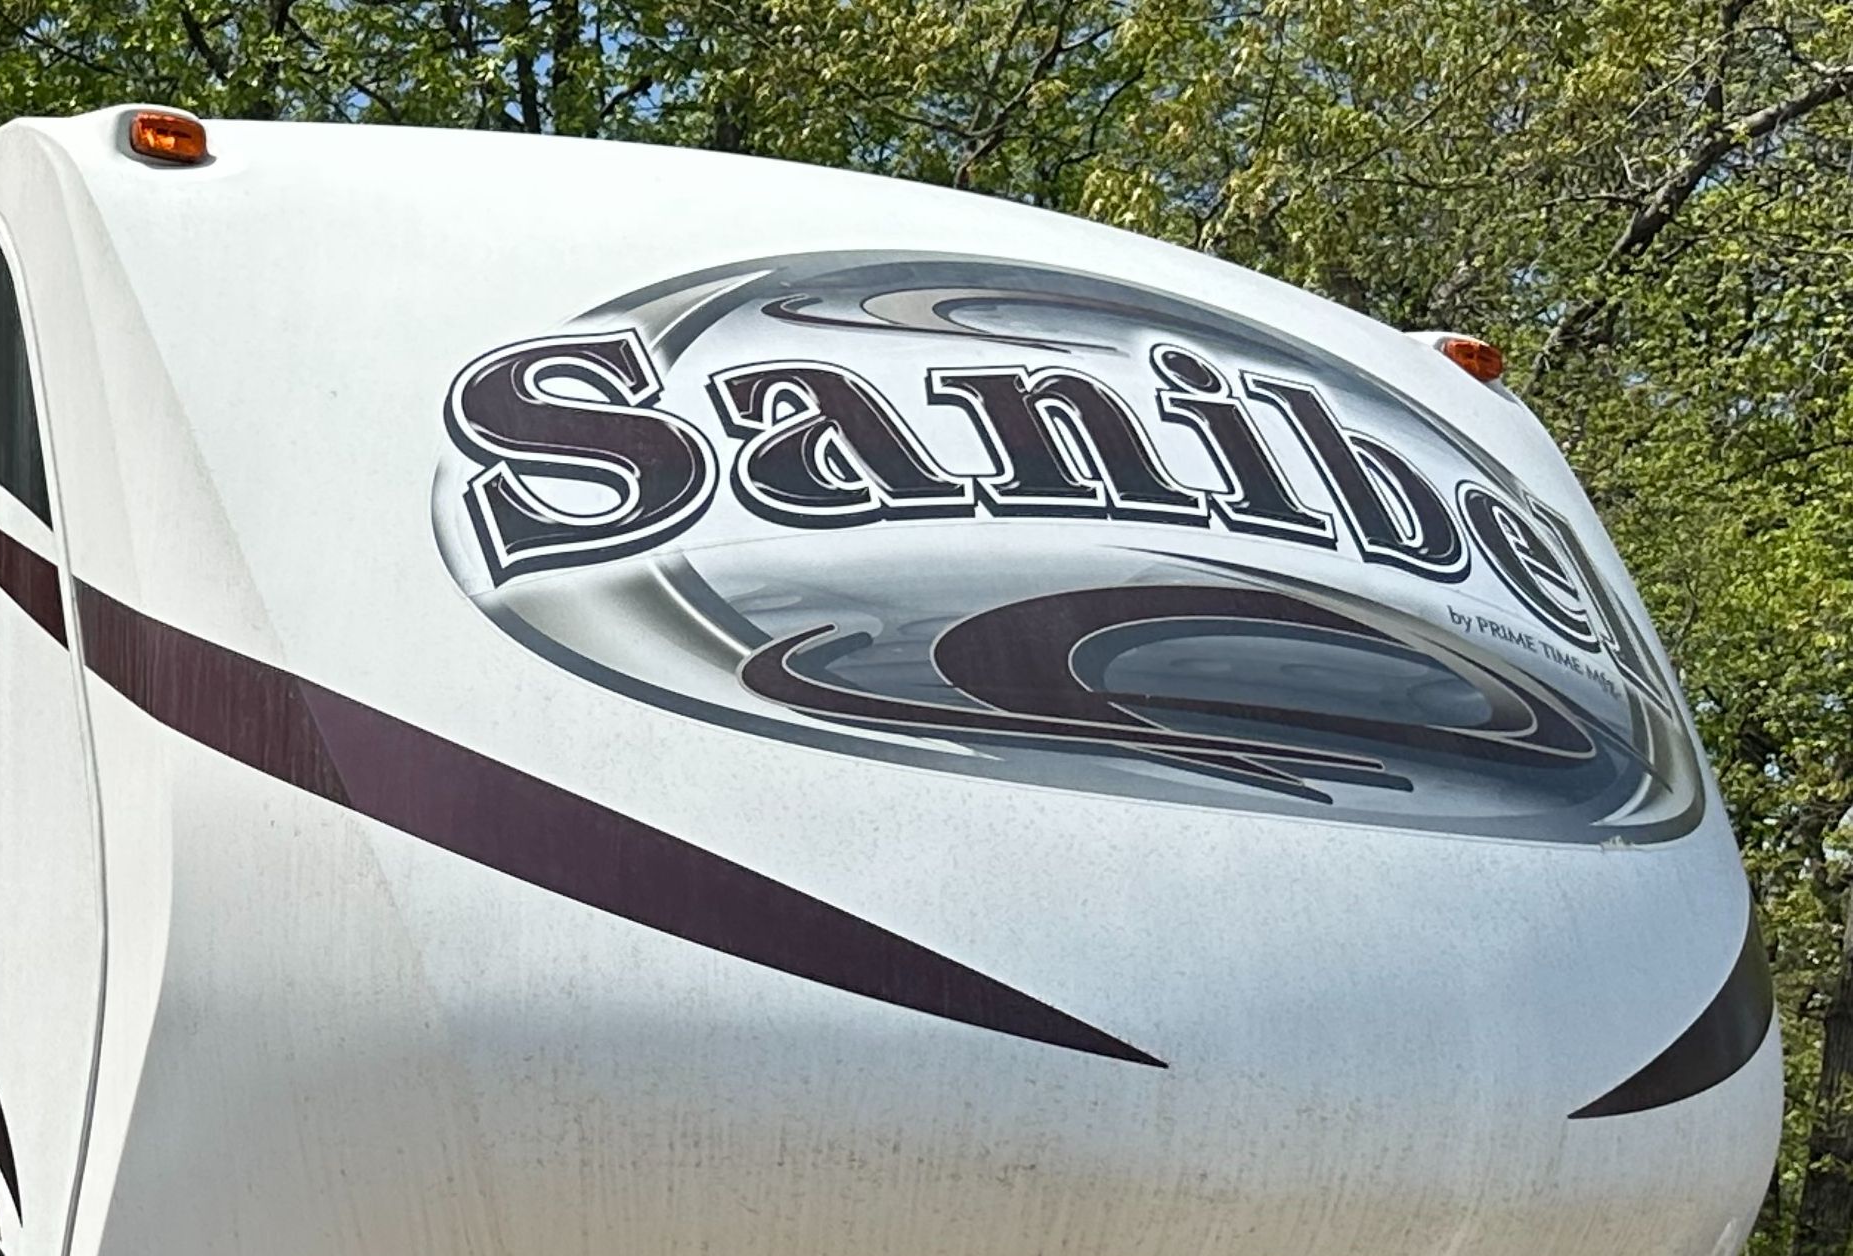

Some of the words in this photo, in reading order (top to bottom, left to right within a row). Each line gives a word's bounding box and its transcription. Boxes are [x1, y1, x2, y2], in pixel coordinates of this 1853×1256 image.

[446, 328, 1673, 719] Sanibel
[1447, 604, 1472, 633] by
[1475, 616, 1537, 653] PRIME
[1538, 640, 1584, 675] TIME
